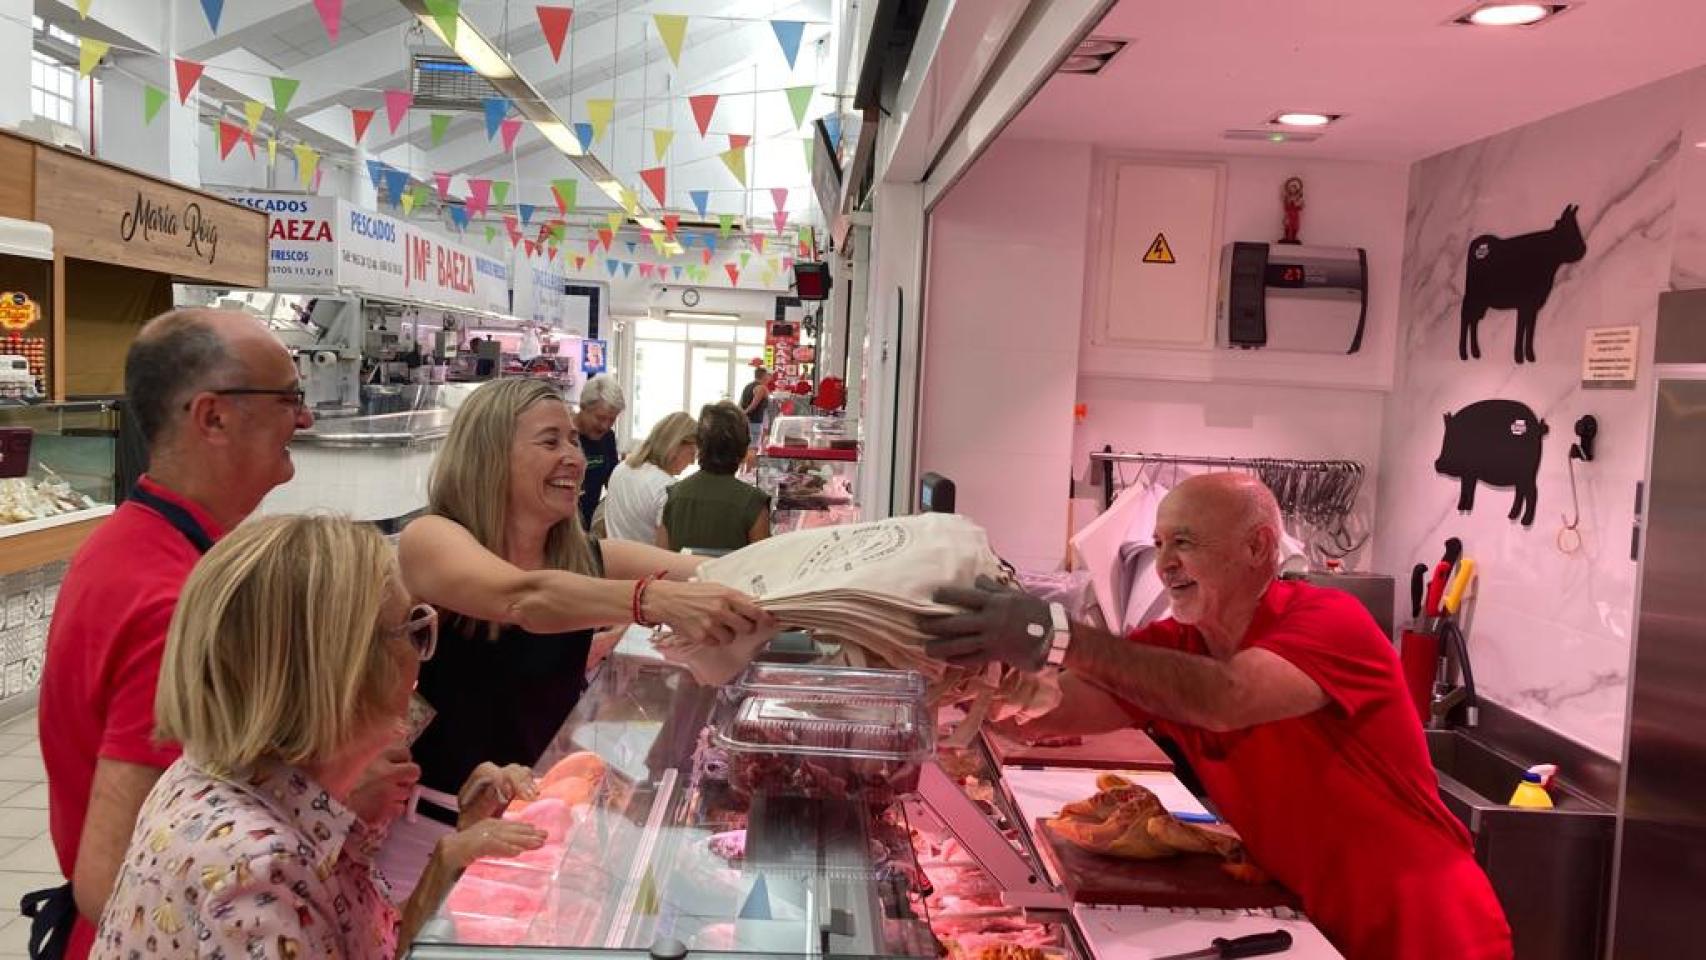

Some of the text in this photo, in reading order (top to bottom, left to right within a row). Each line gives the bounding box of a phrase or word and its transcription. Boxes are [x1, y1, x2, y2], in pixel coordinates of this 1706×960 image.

[184, 203, 218, 264] Roig
[269, 218, 333, 242] AEZA
[351, 211, 396, 243] PESCADOS
[271, 249, 309, 262] FRESCOS
[404, 232, 410, 288] J
[437, 245, 476, 294] BAEZA
